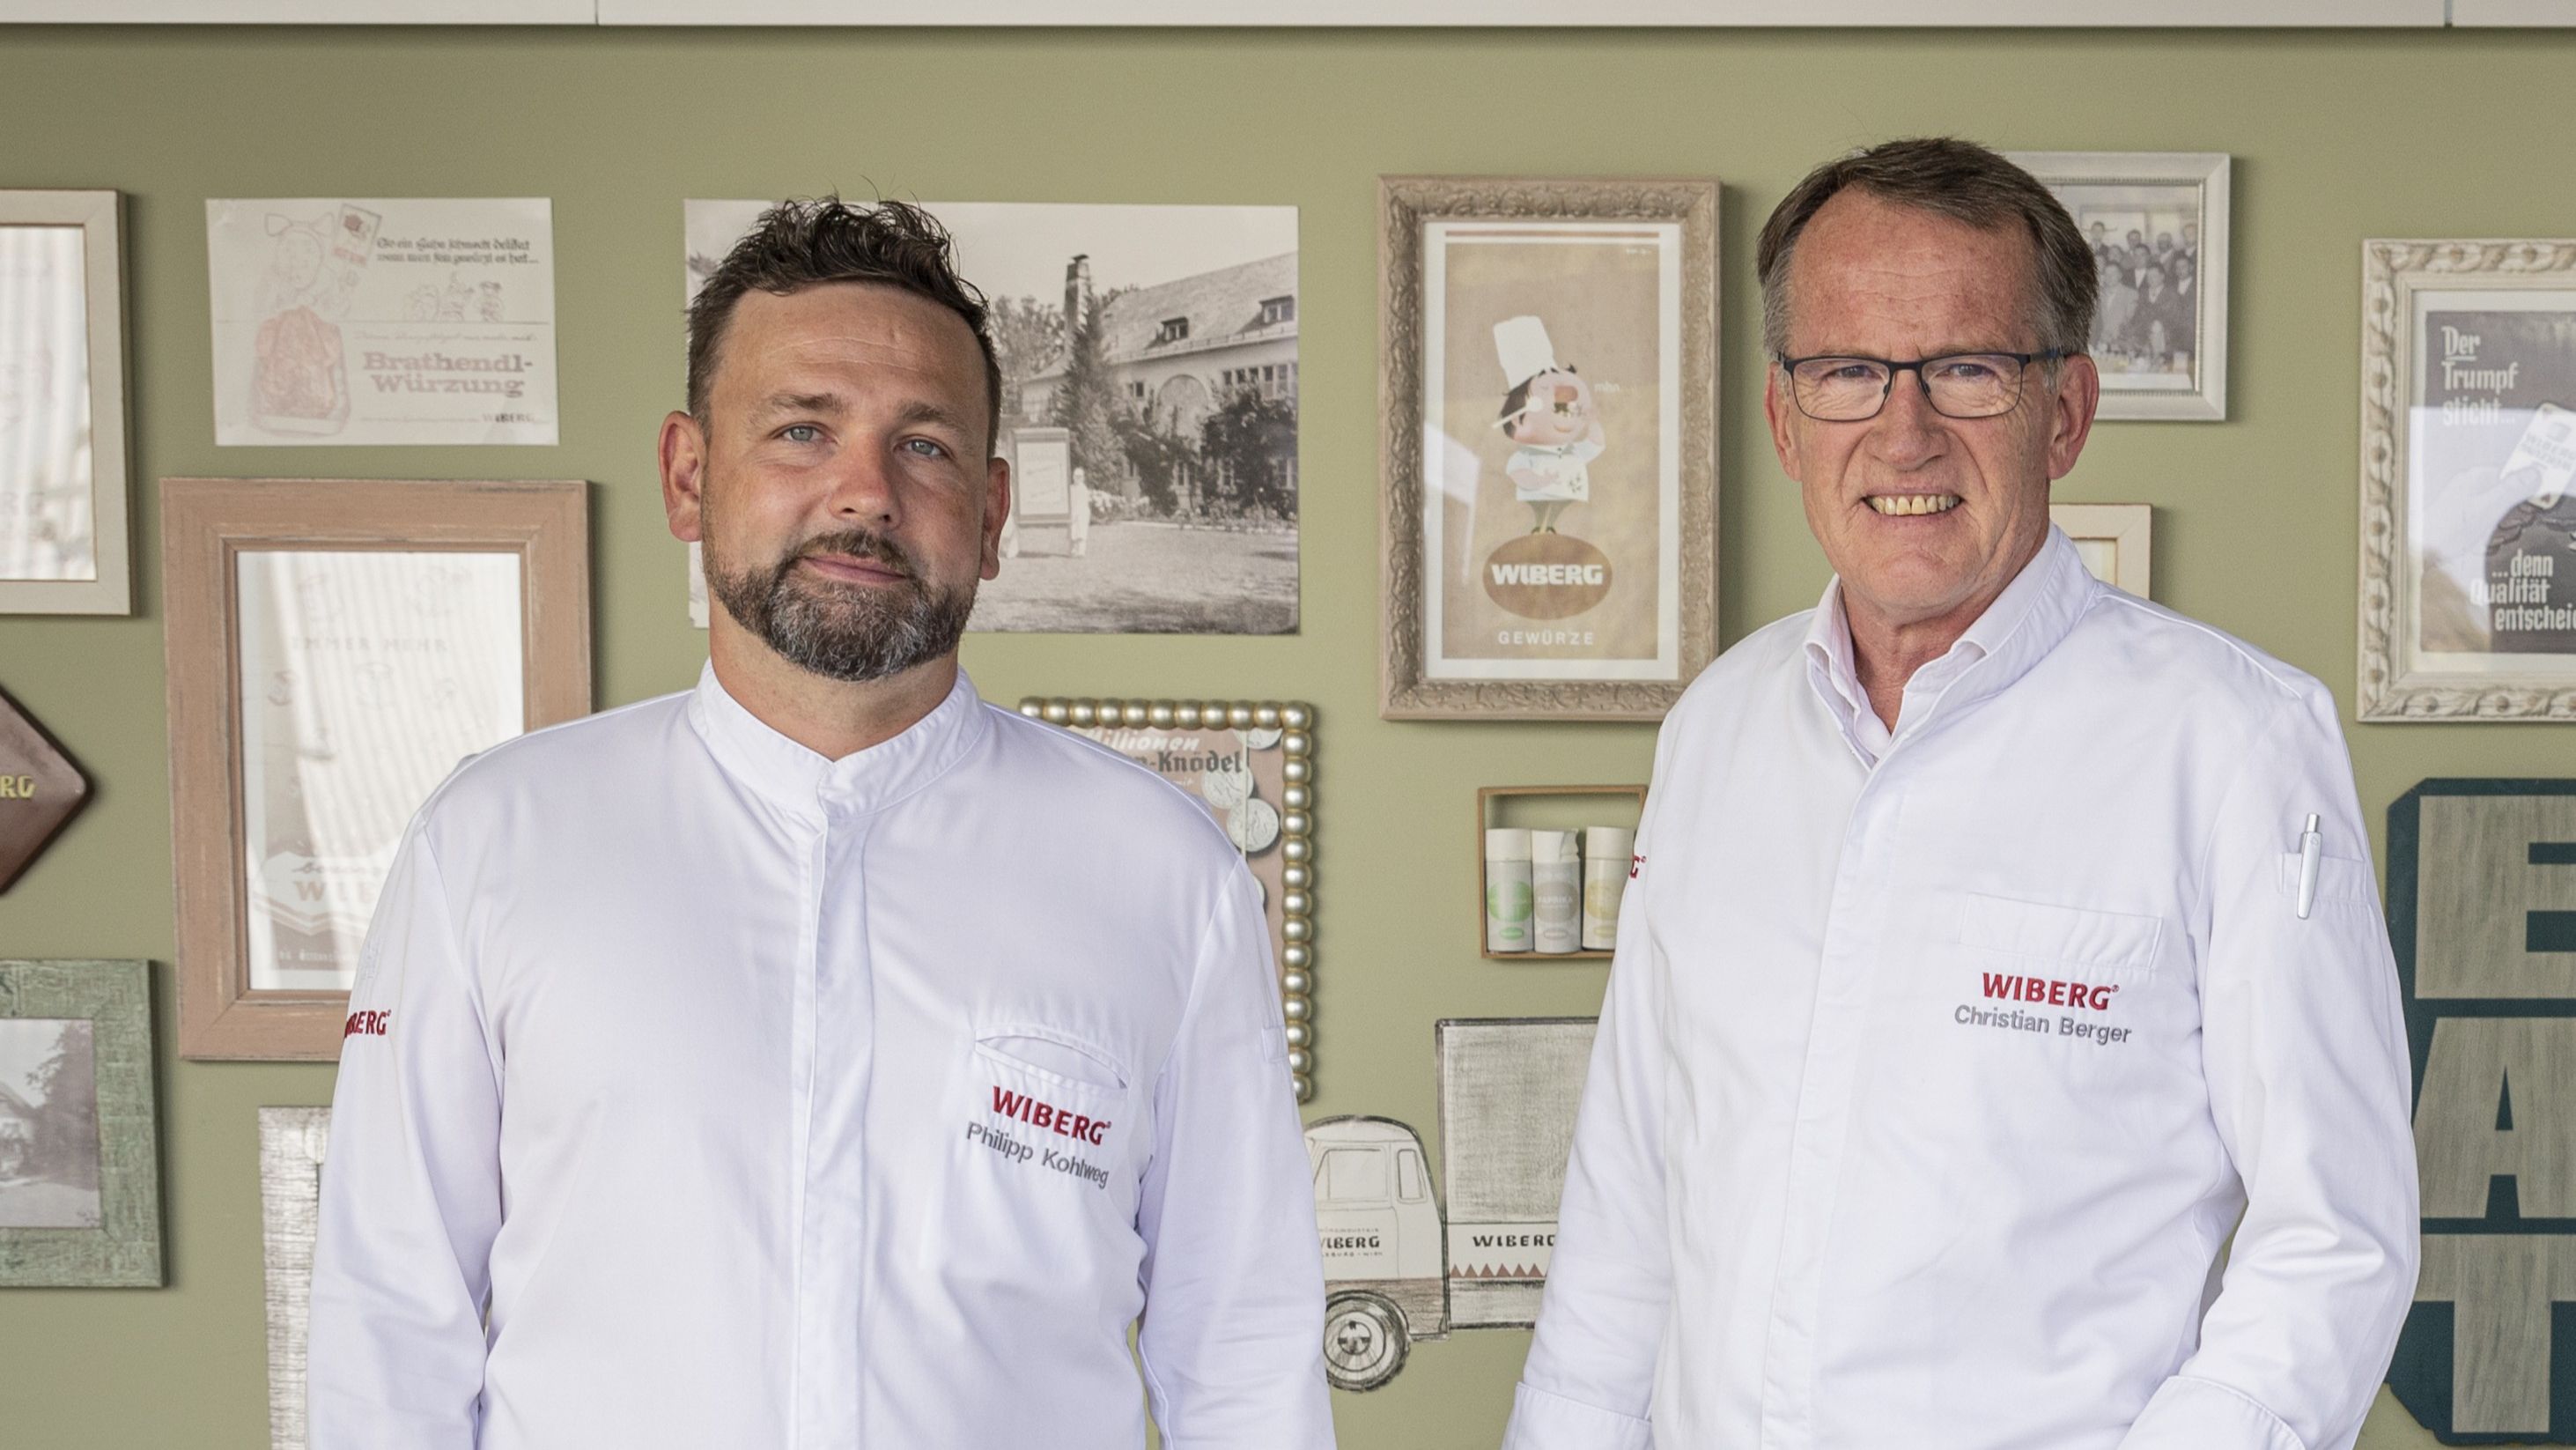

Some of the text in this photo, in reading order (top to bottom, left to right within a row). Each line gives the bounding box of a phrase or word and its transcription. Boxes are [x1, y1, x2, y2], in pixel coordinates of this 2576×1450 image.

[2441, 326, 2481, 356] Der
[362, 351, 533, 373] Brathendl-
[370, 374, 525, 398] Würzung
[2441, 360, 2519, 396] Trumpf
[1491, 564, 1604, 585] WIBERG
[2470, 577, 2551, 606] Qualität
[1498, 628, 1593, 646] GEWÜRZE
[1954, 1004, 2132, 1046] Christian Berger
[966, 1120, 1111, 1190] Philipp Kohlweg
